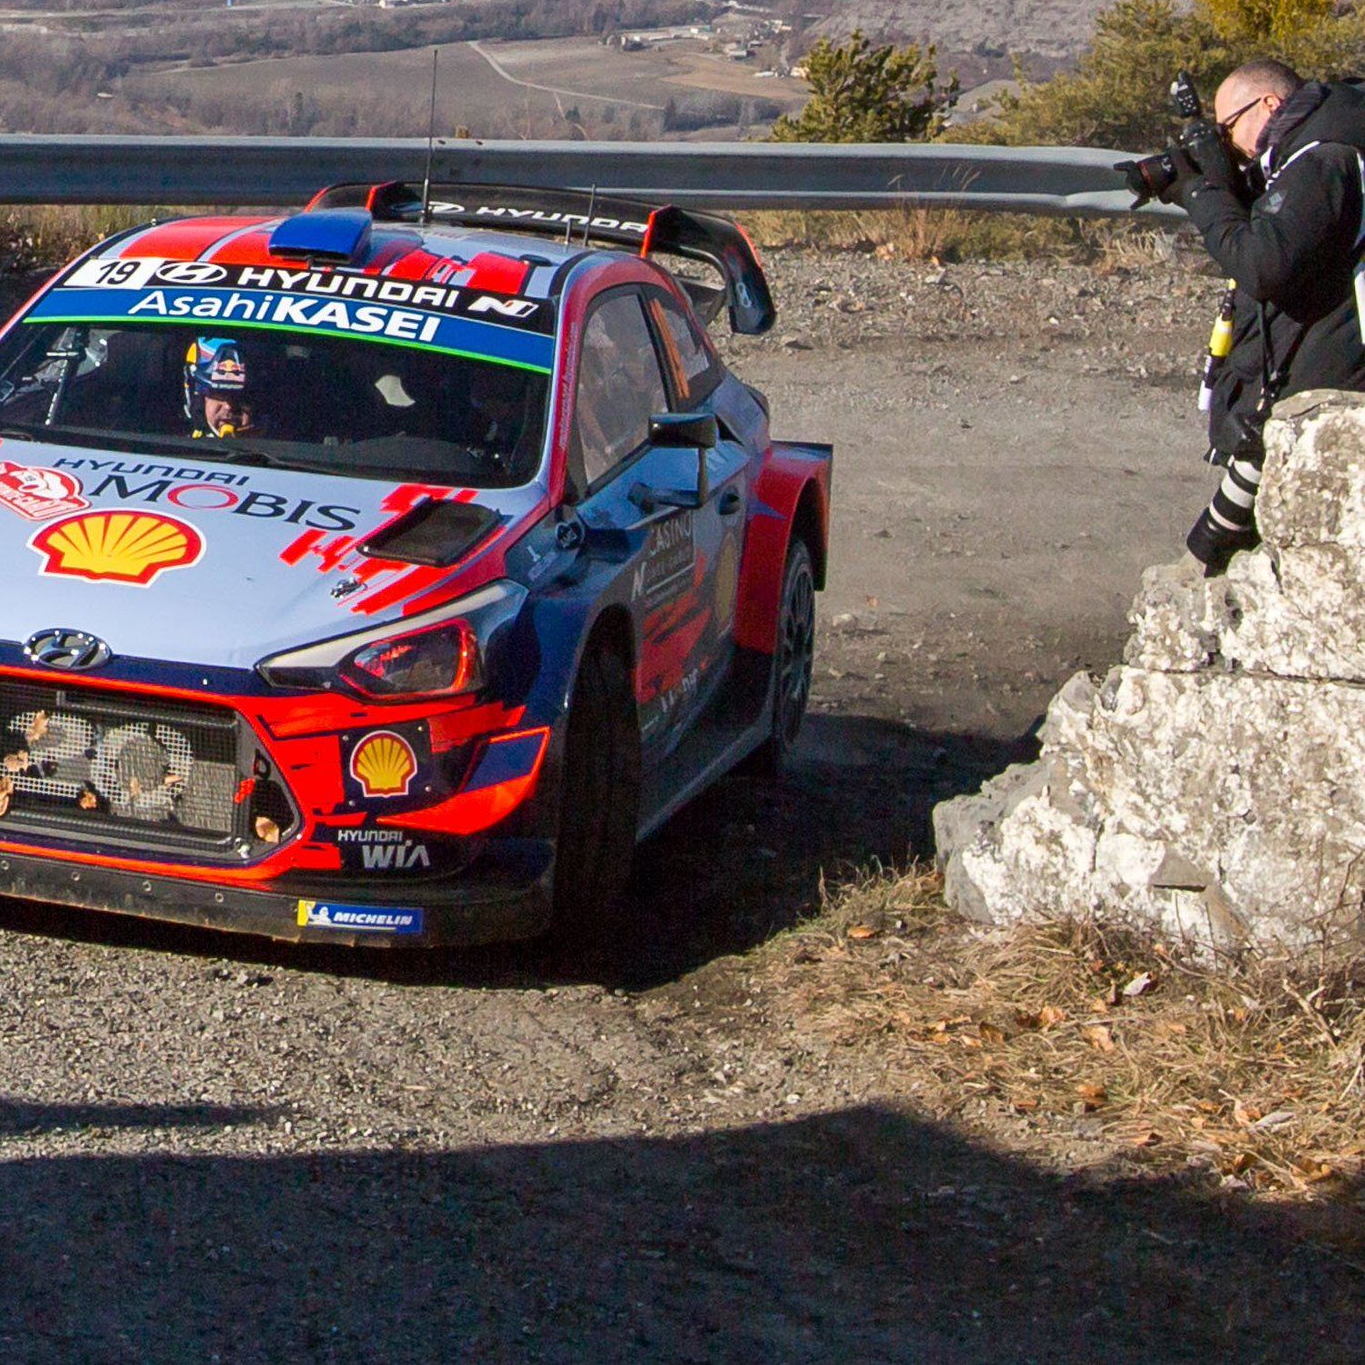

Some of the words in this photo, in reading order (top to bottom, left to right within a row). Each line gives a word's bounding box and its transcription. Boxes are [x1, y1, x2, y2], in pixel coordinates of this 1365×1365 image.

[475, 206, 649, 234] HYUNDA
[95, 260, 142, 286] 19
[237, 266, 460, 309] HYUNDAI
[52, 457, 252, 486] HYUNDAI
[88, 474, 363, 532] MOBIS
[337, 829, 404, 842] HYUNDAI
[332, 911, 414, 926] MICHELIN
